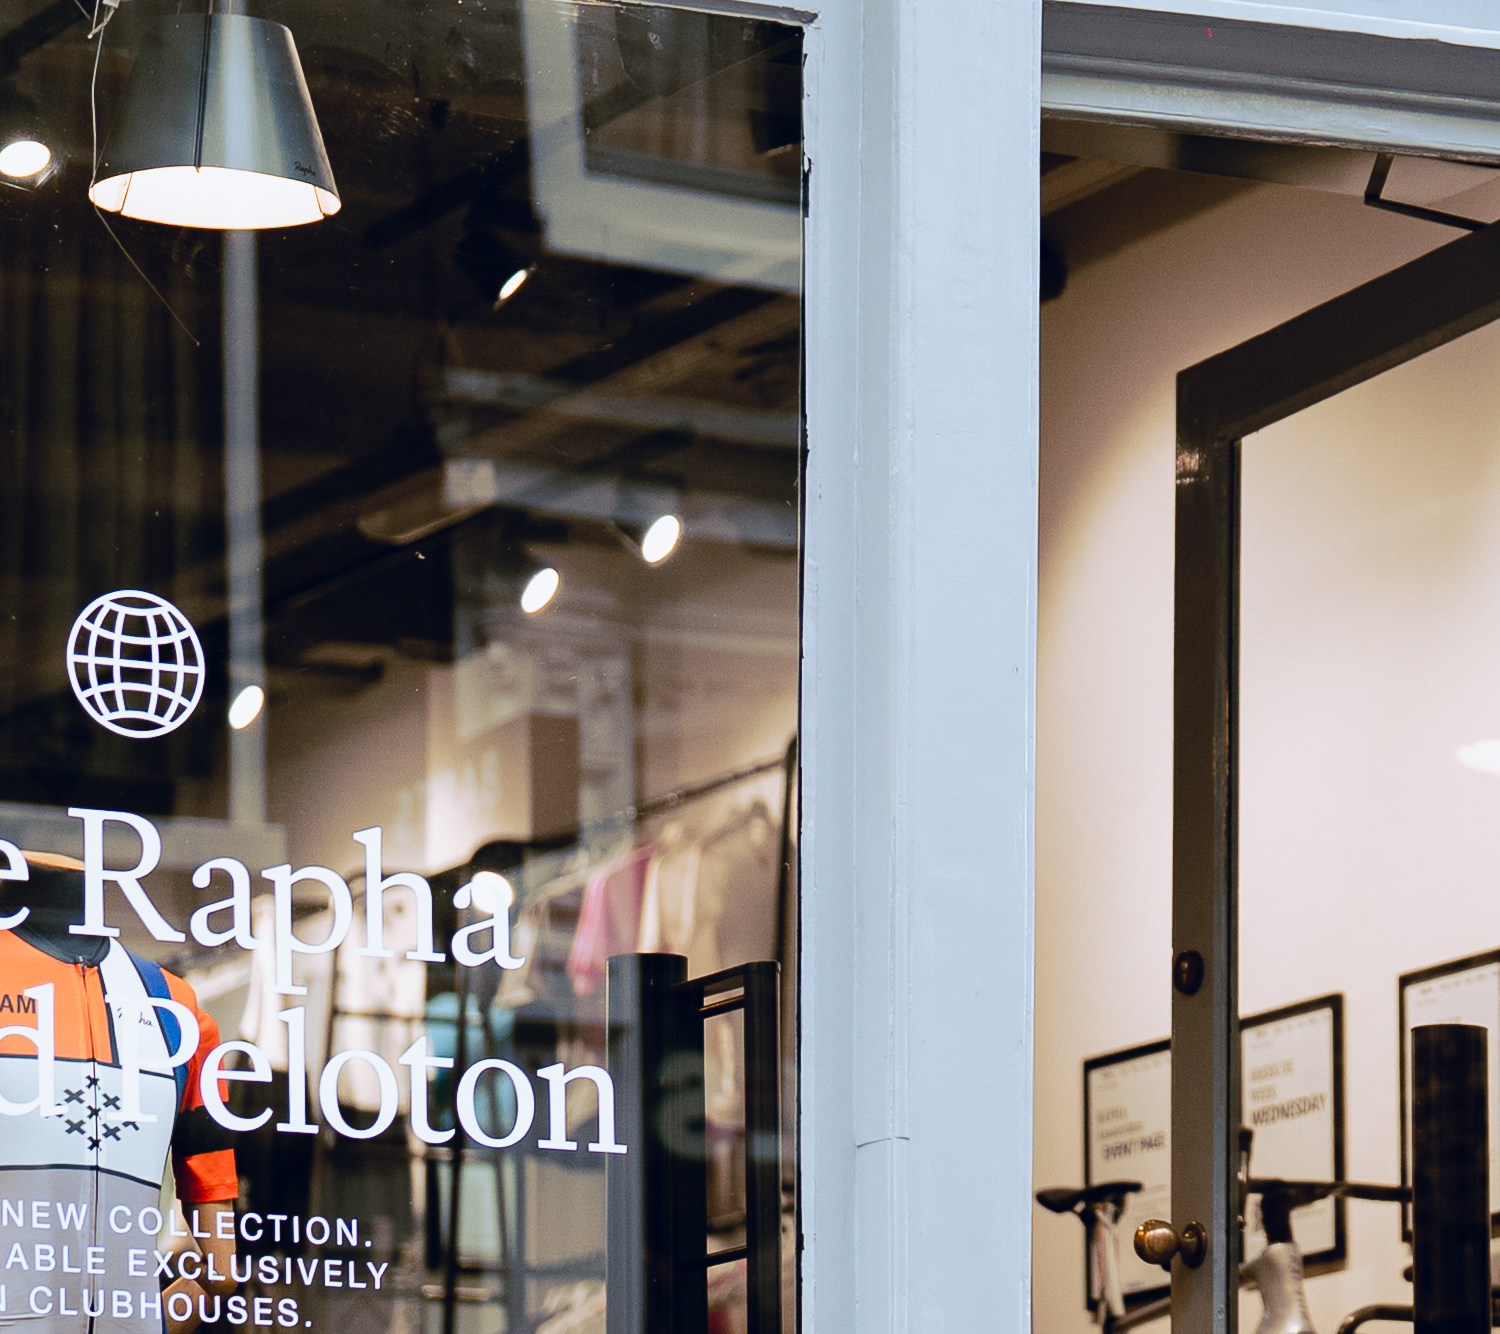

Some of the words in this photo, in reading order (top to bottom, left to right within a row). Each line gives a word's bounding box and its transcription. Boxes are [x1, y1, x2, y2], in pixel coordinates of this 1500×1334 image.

[68, 806, 527, 997] Rapha
[105, 993, 628, 1155] Peloton
[0, 1197, 88, 1231] NEW
[108, 1205, 373, 1247] COLLECTION.
[127, 1244, 389, 1290] EXCLUSIVELY
[28, 1286, 314, 1327] CLUBHOUSES.
